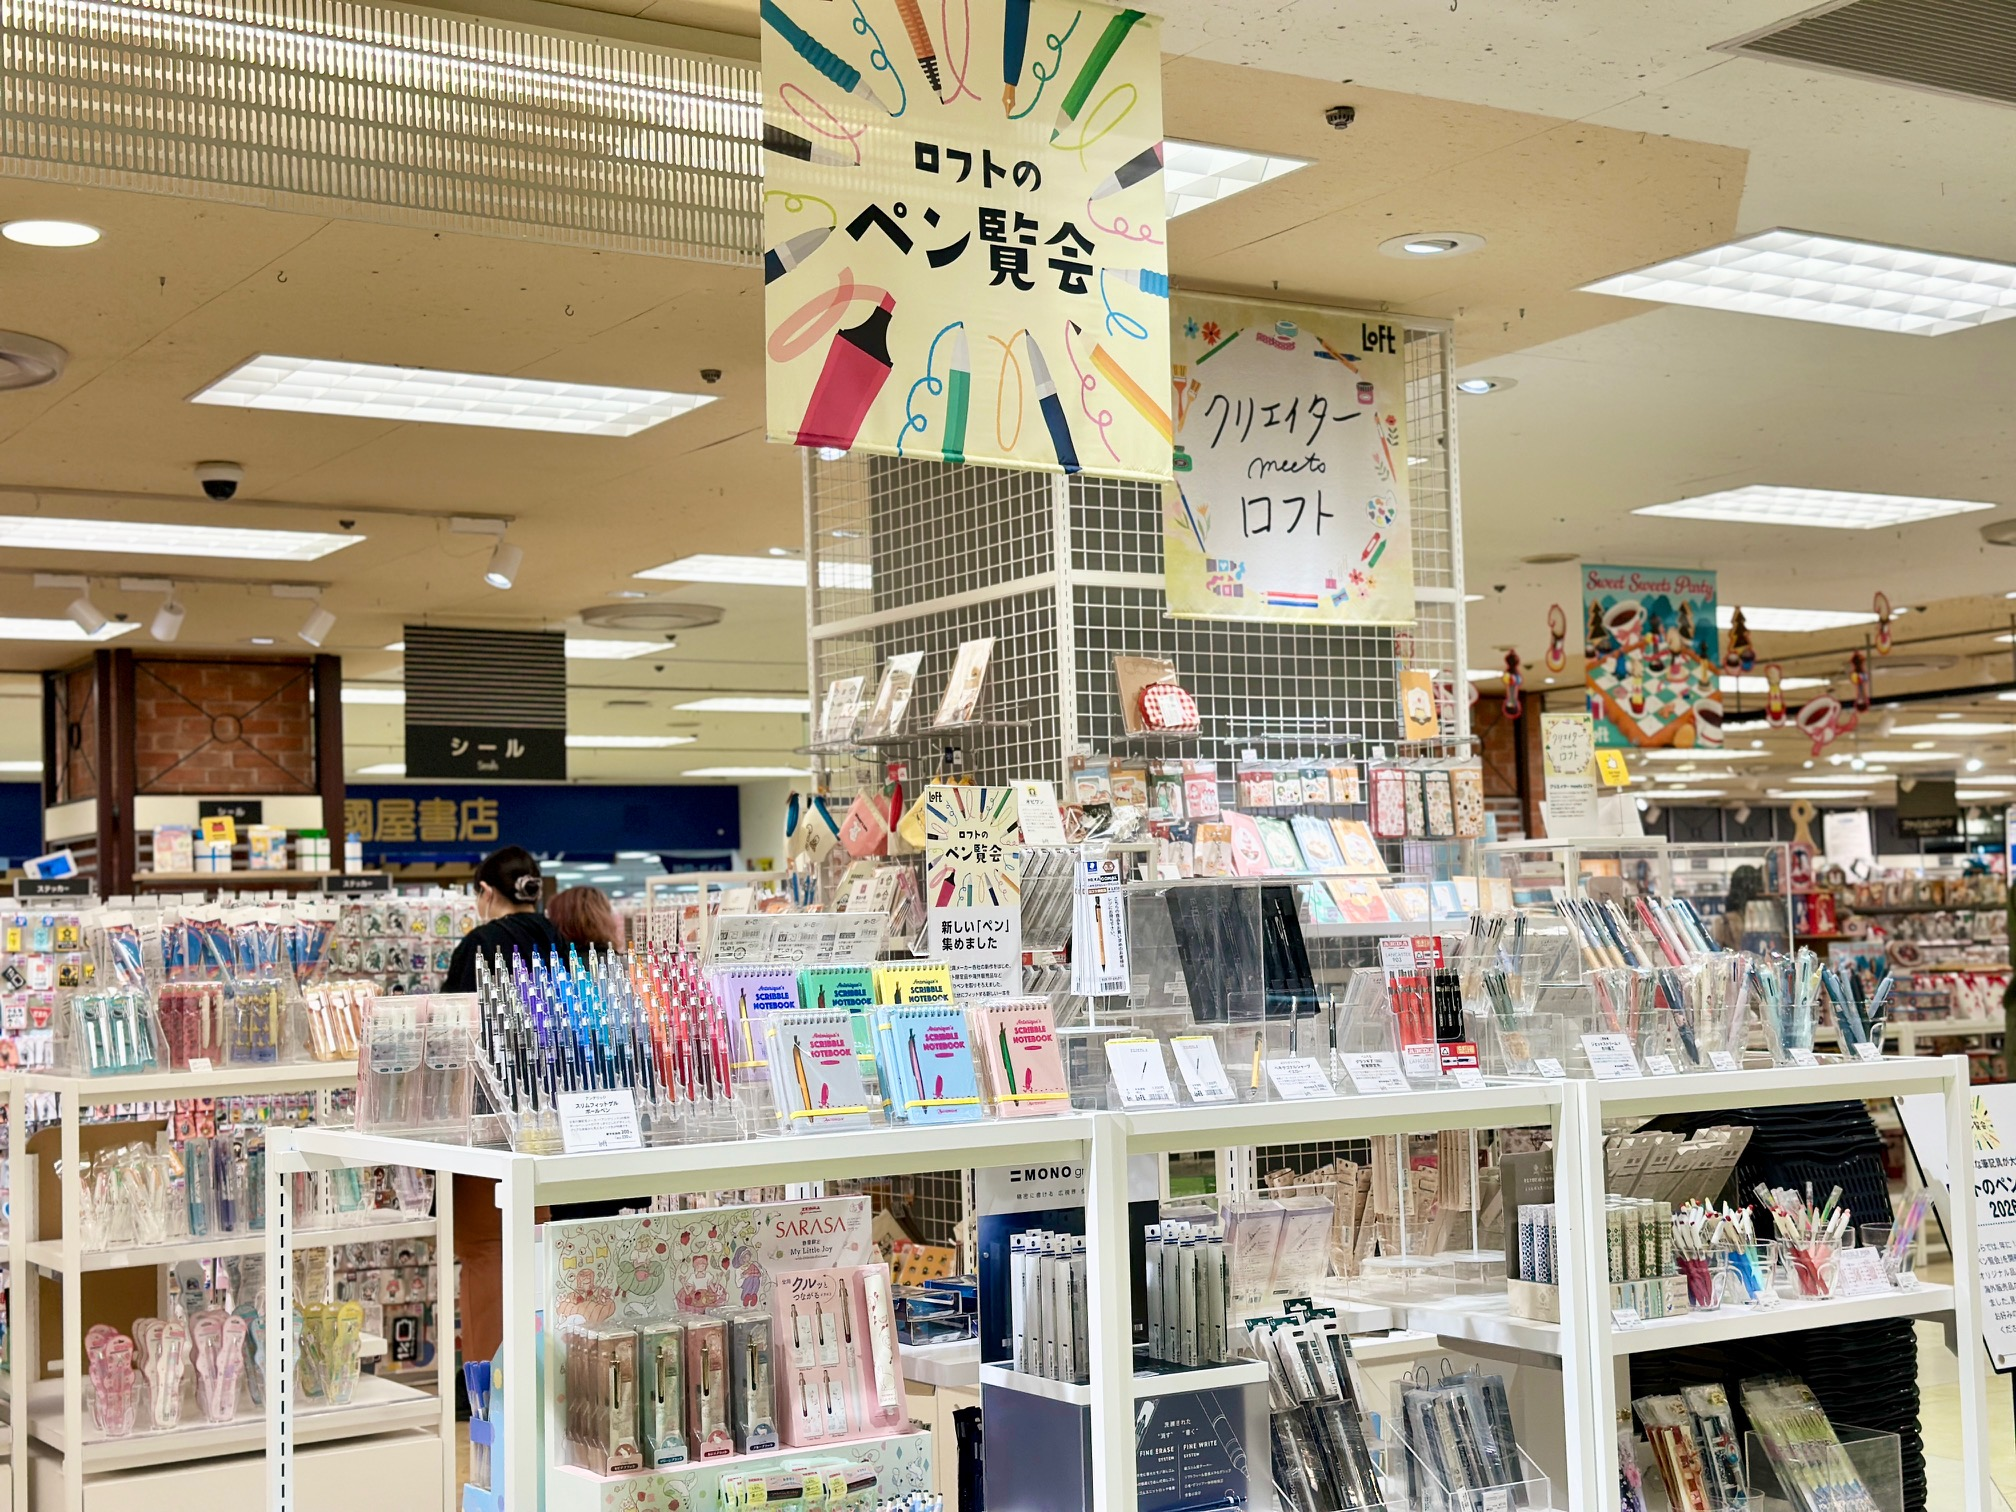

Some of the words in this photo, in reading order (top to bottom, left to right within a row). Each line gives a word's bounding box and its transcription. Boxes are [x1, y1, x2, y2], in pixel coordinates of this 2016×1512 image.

[914, 141, 1042, 192] ロフトの
[846, 201, 1096, 294] ペン覧会
[1204, 394, 1362, 449] クリエイター
[1247, 455, 1327, 480] meets
[1239, 489, 1335, 537] ロフト
[1586, 570, 1625, 591] Sweet
[1629, 572, 1671, 593] Sweets
[1674, 576, 1713, 602] Party
[451, 737, 525, 758] シール
[958, 830, 989, 840] ロフトの
[945, 843, 1002, 864] ペン覧会
[36, 884, 70, 894] ステッカー
[343, 879, 373, 889] ステッカー
[941, 919, 1010, 934] 新しい「ペン」
[941, 937, 998, 951] 集めました
[834, 989, 867, 997] SCRIBBLE
[910, 985, 943, 994] SCRIBBLE
[755, 992, 790, 1000] SCRIBBLE
[908, 994, 949, 1003] NOTEBOOK
[753, 1000, 796, 1009] NOTEBOOK
[832, 998, 872, 1006] NOTEBOOK
[1014, 1026, 1046, 1035] SCRIBBLE
[925, 1032, 959, 1042] SCRIBBLE
[1013, 1034, 1053, 1044] NOTEBOOK
[810, 1039, 845, 1048] SCRIBBLE
[923, 1041, 966, 1051] NOTEBOOK
[575, 1101, 619, 1109] スリムフィットゲル
[1024, 1166, 1071, 1182] MONO
[775, 1216, 846, 1239] SARASA
[790, 1248, 801, 1257] My
[802, 1246, 820, 1254] Little
[822, 1245, 833, 1254] Joy
[792, 1276, 828, 1293] クルッと
[793, 1292, 820, 1301] つながる
[1183, 1442, 1197, 1450] FINE
[1198, 1439, 1218, 1448] WRITE
[1139, 1448, 1153, 1458] FINE
[1155, 1445, 1175, 1455] ERASE
